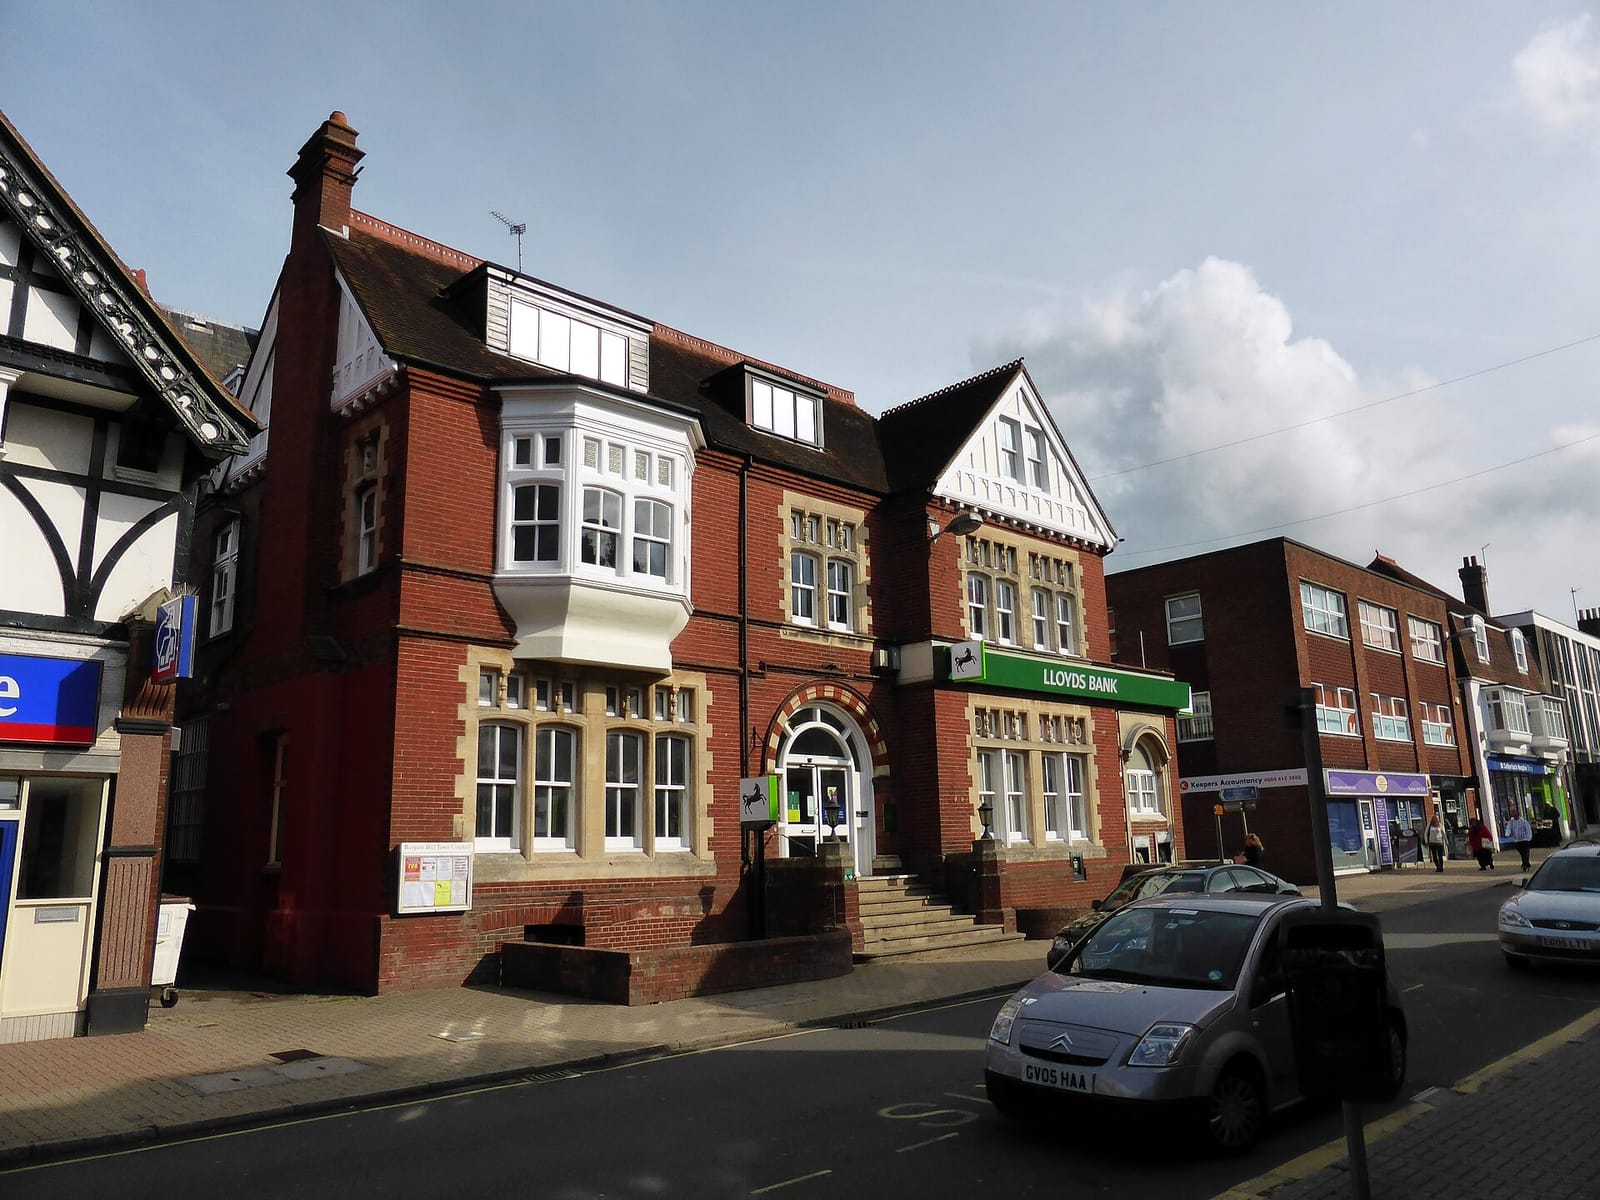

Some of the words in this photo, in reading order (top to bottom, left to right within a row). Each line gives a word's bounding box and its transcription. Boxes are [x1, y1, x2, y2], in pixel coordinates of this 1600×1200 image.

[1043, 668, 1086, 689] LLOYDS
[1088, 675, 1118, 694] BANK
[1190, 780, 1218, 789] Keepers
[1219, 777, 1263, 786] Accountancy
[1026, 1064, 1057, 1085] GV05
[1060, 1071, 1087, 1090] HAA
